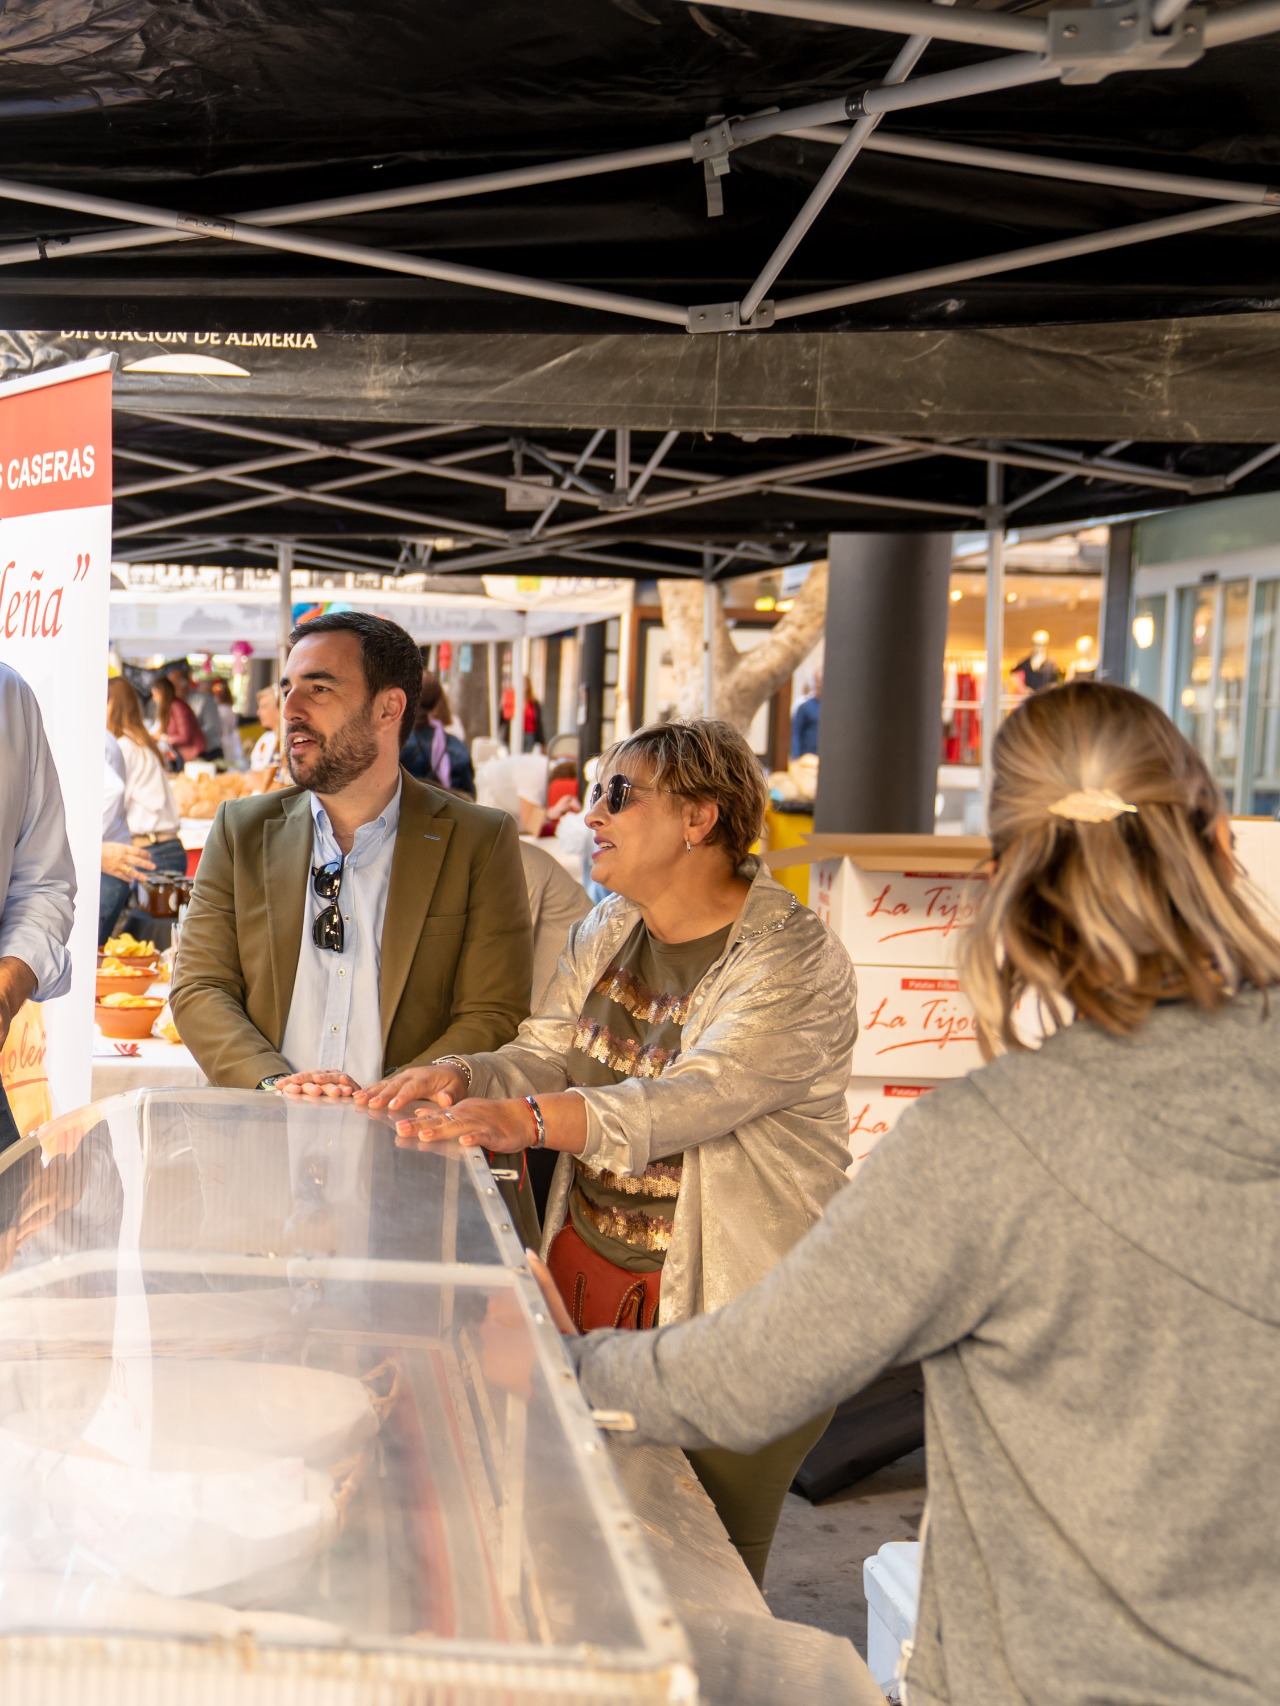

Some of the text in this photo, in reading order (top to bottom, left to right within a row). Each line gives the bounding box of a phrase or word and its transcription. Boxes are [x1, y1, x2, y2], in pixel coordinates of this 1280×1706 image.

[7, 445, 95, 490] CASERAS
[866, 884, 978, 937] La Tijo
[864, 997, 907, 1030] La
[850, 1104, 889, 1134] La
